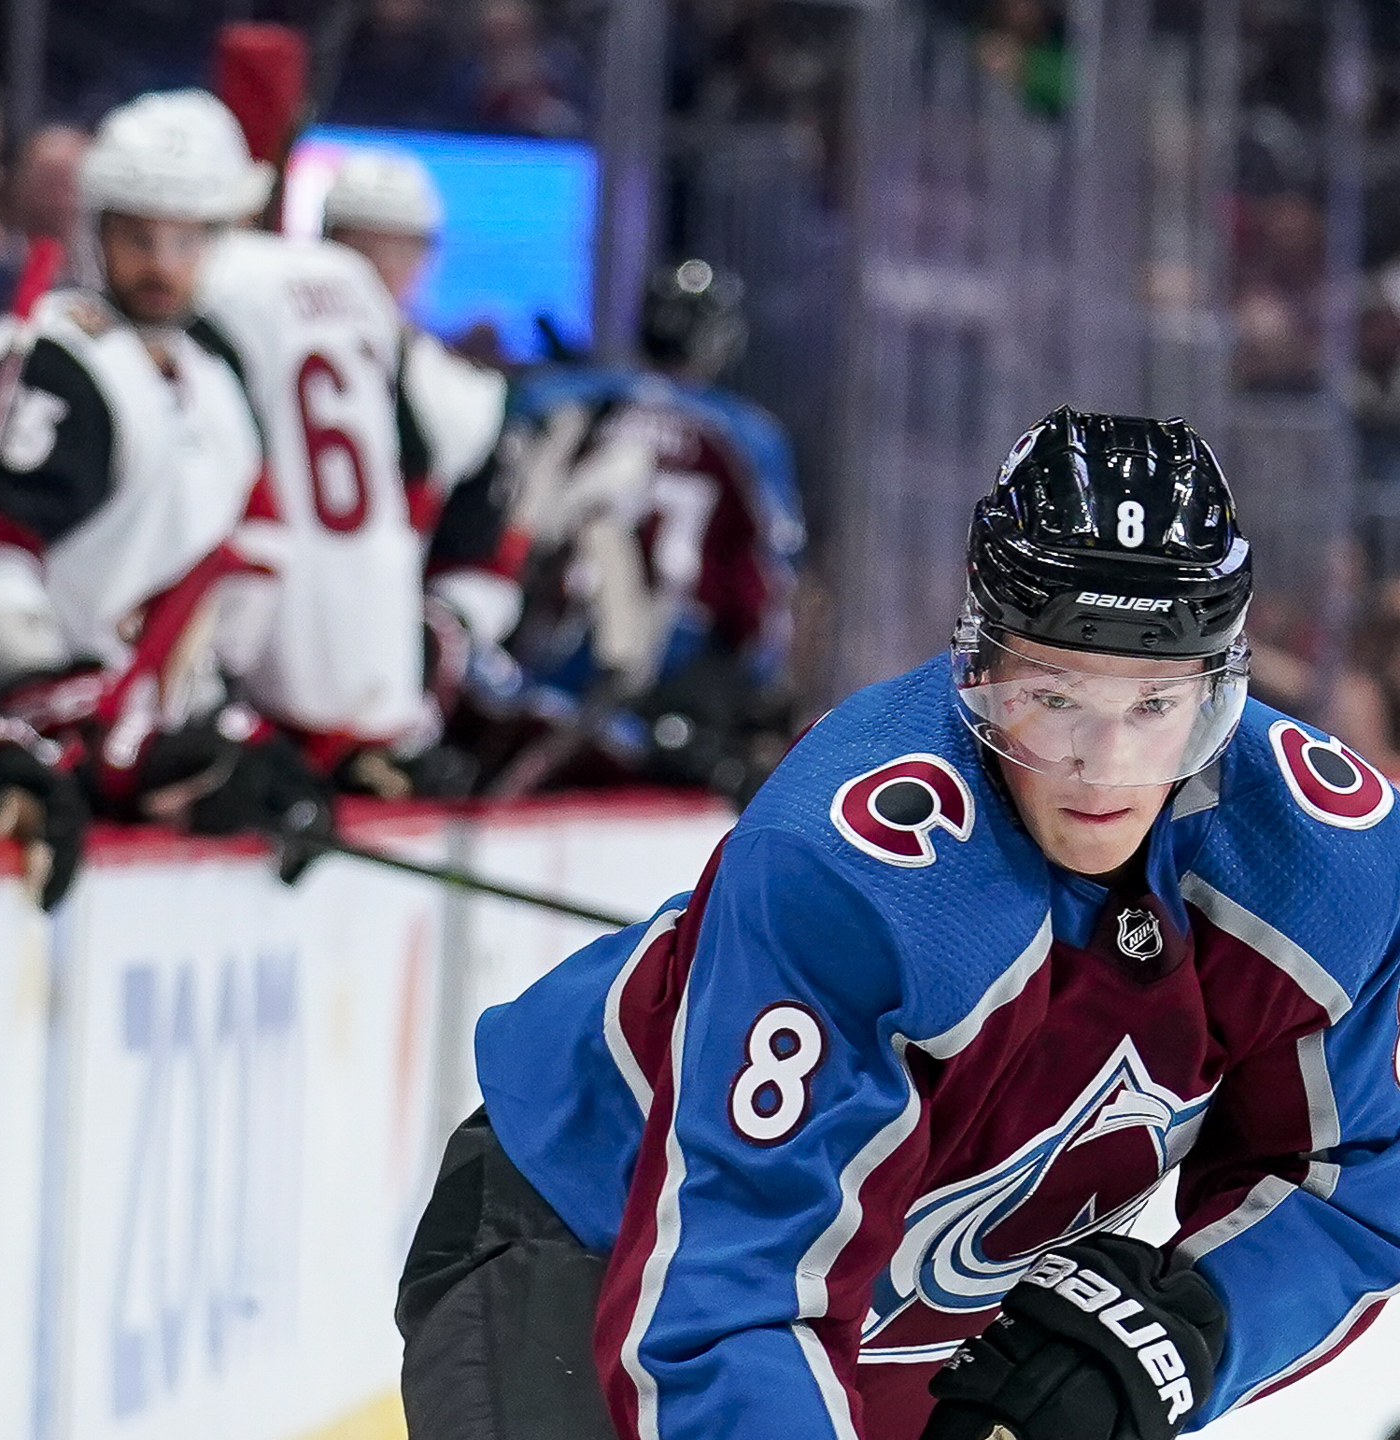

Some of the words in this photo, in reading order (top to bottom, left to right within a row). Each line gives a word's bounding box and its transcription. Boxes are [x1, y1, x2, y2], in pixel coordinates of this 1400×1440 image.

[297, 352, 368, 533] 6
[1117, 500, 1145, 548] 8
[1075, 591, 1173, 612] BAUER
[727, 999, 827, 1147] 8
[1019, 1253, 1195, 1425] BAUER
